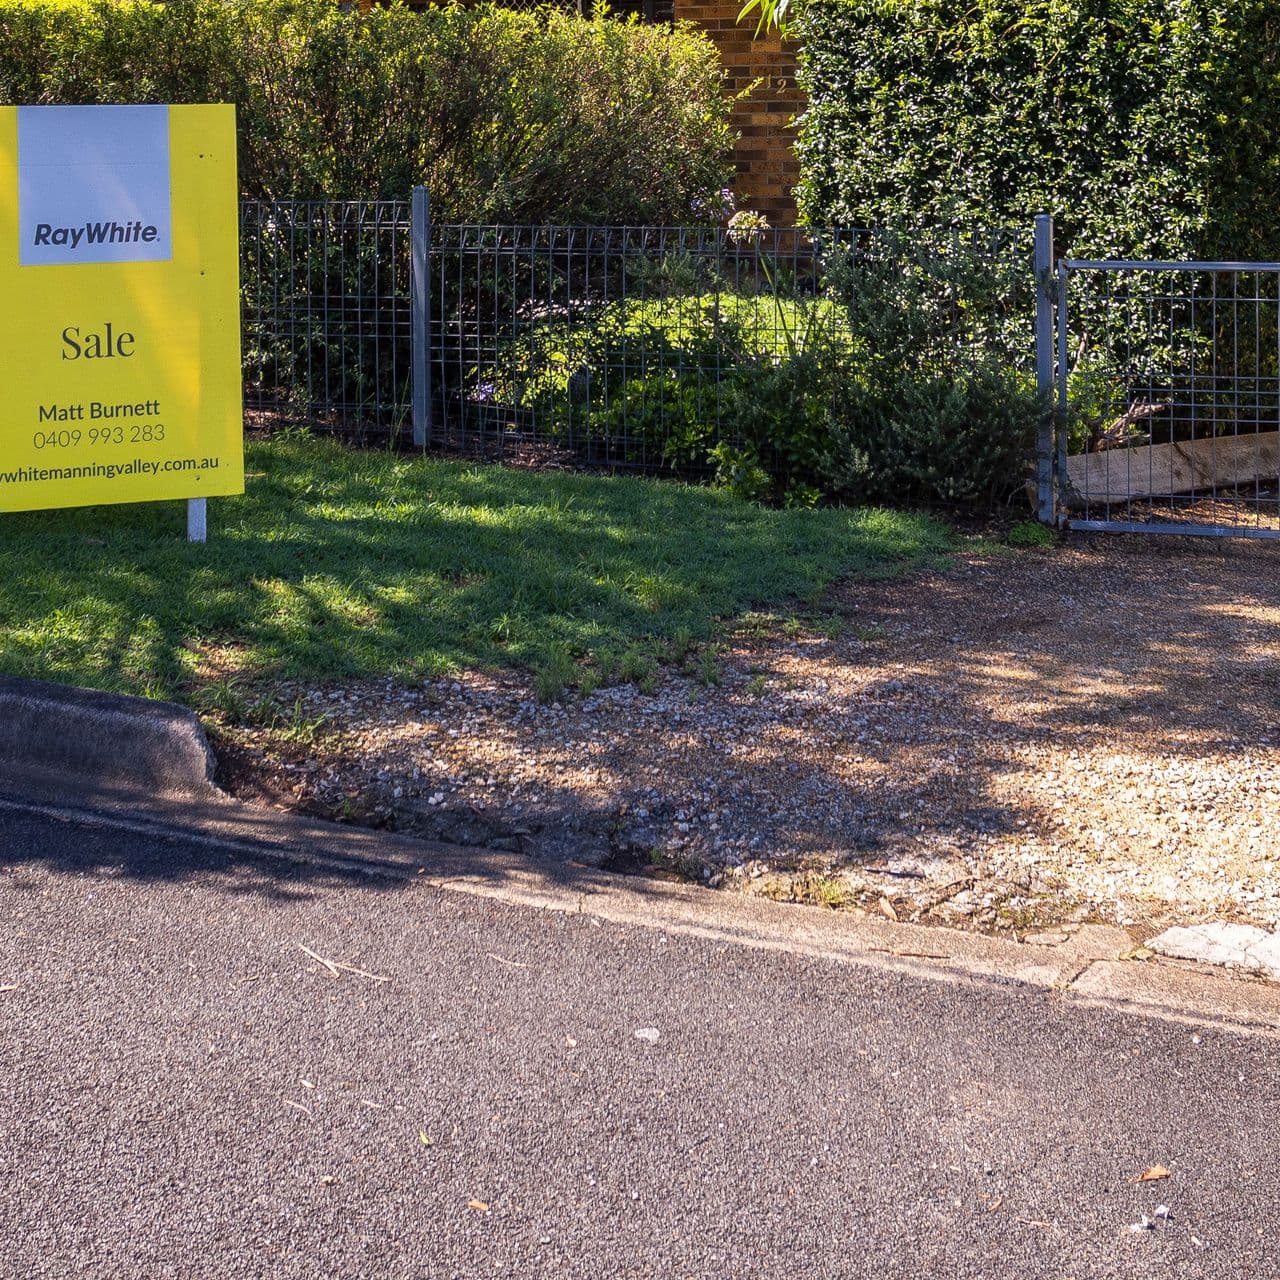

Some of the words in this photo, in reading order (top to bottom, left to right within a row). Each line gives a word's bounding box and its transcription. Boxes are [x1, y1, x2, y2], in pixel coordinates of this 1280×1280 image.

[766, 73, 787, 95] 12
[62, 322, 136, 361] Sale
[39, 404, 84, 423] Matt
[90, 399, 161, 420] Burnett
[33, 429, 82, 449] 0409
[88, 426, 124, 446] 993
[130, 423, 166, 443] 283
